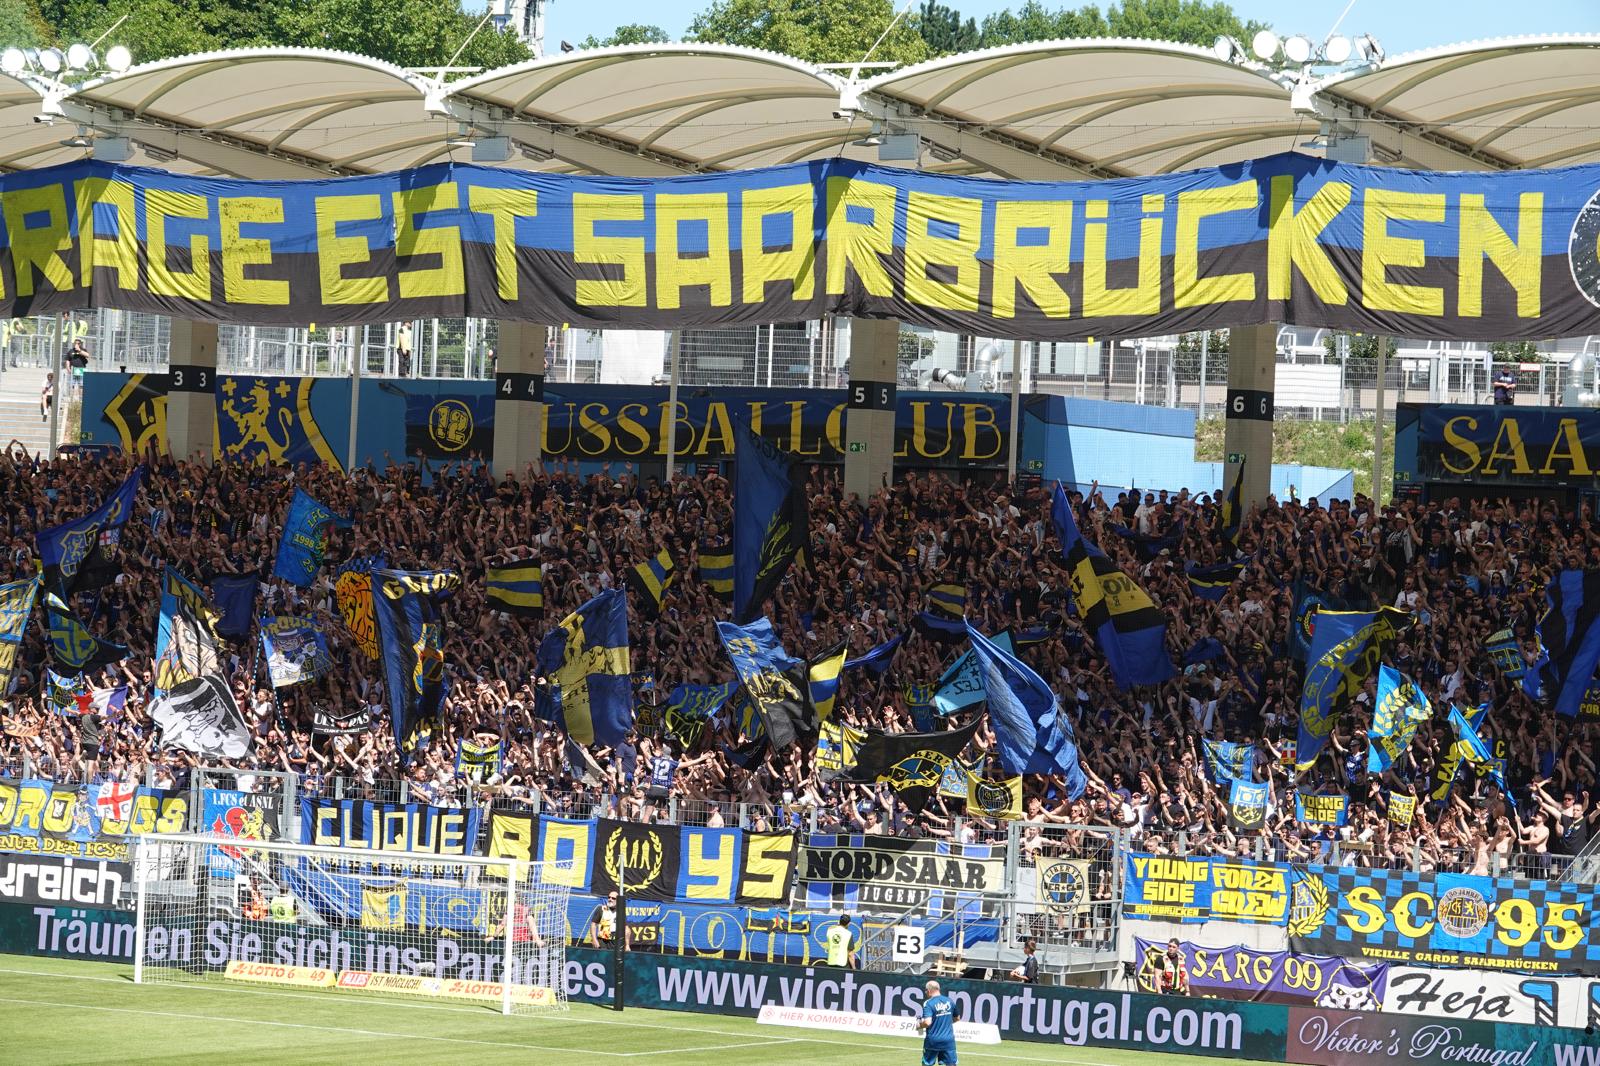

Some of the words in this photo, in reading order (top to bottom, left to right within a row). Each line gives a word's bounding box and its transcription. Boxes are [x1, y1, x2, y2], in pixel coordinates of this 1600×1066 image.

[0, 177, 290, 305] RAGE
[314, 181, 538, 306] EST
[573, 175, 1543, 318] SAARBRÜCKEN
[174, 371, 184, 386] 3
[200, 371, 207, 387] 3
[502, 379, 512, 394] 4
[527, 379, 534, 395] 4
[855, 387, 865, 403] 5
[881, 388, 888, 404] 5
[1233, 396, 1244, 413] 6
[1260, 397, 1266, 415] 6
[1440, 415, 1600, 476] SAA
[653, 759, 670, 780] 12
[315, 807, 465, 855] CLIQUE
[806, 849, 987, 890] NORDSAAR
[1133, 858, 1209, 882] YOUNG
[1143, 881, 1195, 903] SIDE
[34, 907, 191, 963] Träumen
[203, 919, 262, 967] Sie
[274, 927, 349, 972] sich
[366, 933, 423, 974] ins
[896, 935, 921, 955] E3
[1361, 947, 1410, 960] VIEILLE
[1415, 951, 1459, 964] GARDE
[1464, 956, 1559, 971] SAARBRÜCKEN
[248, 965, 285, 978] LOTTO
[287, 968, 295, 979] 6
[310, 970, 326, 982] 49
[1191, 949, 1273, 985] SARG
[1283, 957, 1322, 990] 99
[465, 983, 504, 996] LOTTO
[1390, 973, 1514, 1020] Heja
[779, 1011, 803, 1021] HIER
[806, 1014, 855, 1025] KOMMST
[858, 1017, 873, 1027] DU
[878, 1019, 896, 1029] INS
[899, 1021, 918, 1031] SPI
[1299, 1015, 1399, 1058] Victor's
[1409, 1022, 1538, 1066] Portugal
